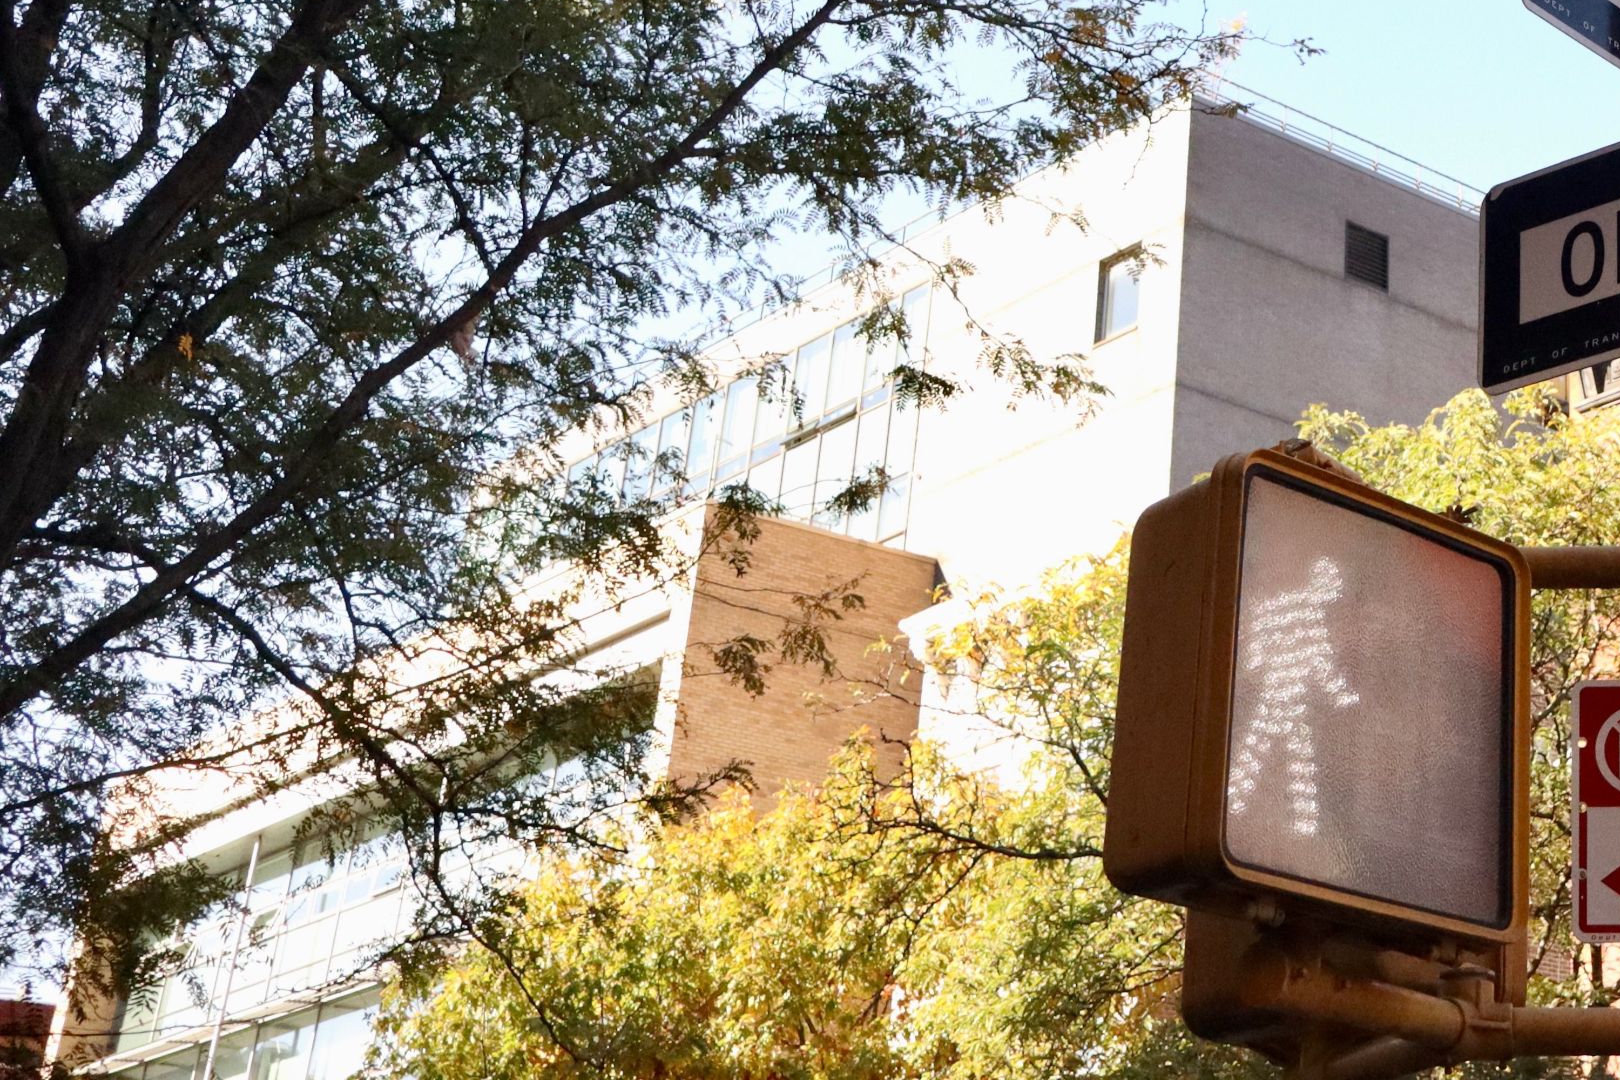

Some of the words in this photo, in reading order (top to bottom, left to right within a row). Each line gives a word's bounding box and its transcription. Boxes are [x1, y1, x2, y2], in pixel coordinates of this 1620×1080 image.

[1583, 21, 1596, 33] OF
[1503, 356, 1536, 374] DEPT
[1551, 346, 1569, 360] OF
